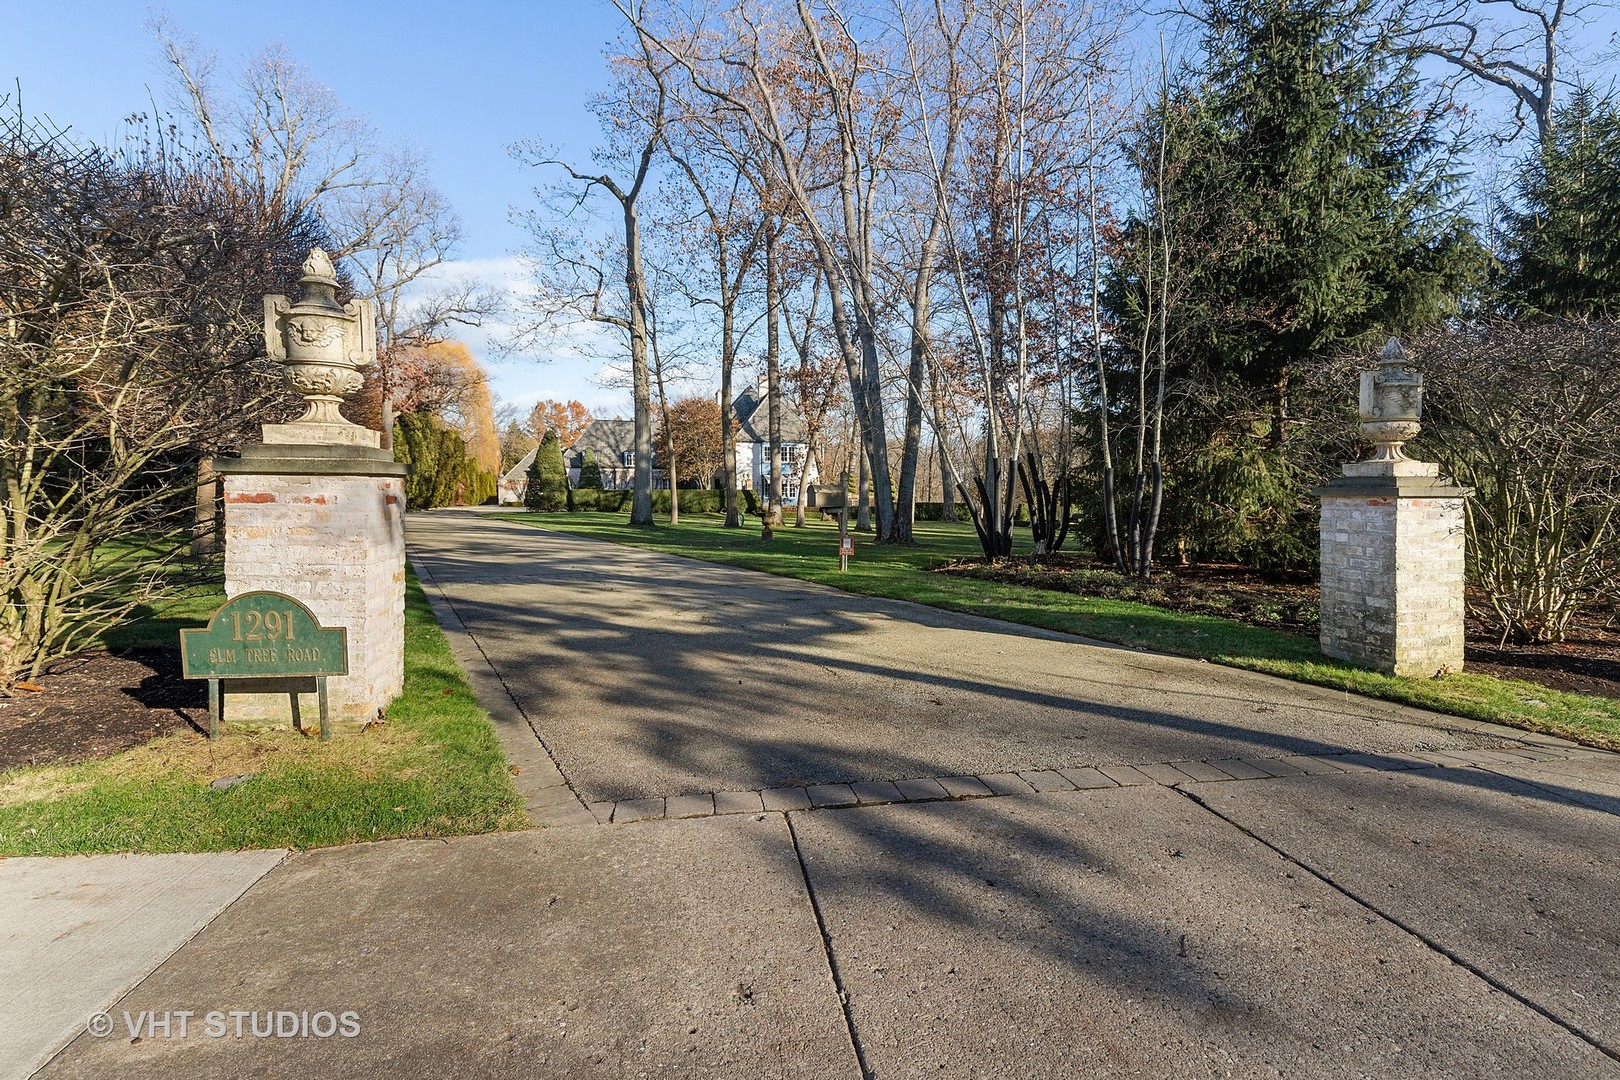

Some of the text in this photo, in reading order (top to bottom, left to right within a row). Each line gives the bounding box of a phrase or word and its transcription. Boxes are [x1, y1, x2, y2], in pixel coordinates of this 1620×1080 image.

[230, 610, 296, 641] 1291
[208, 648, 320, 664] ELM TREE ROAD
